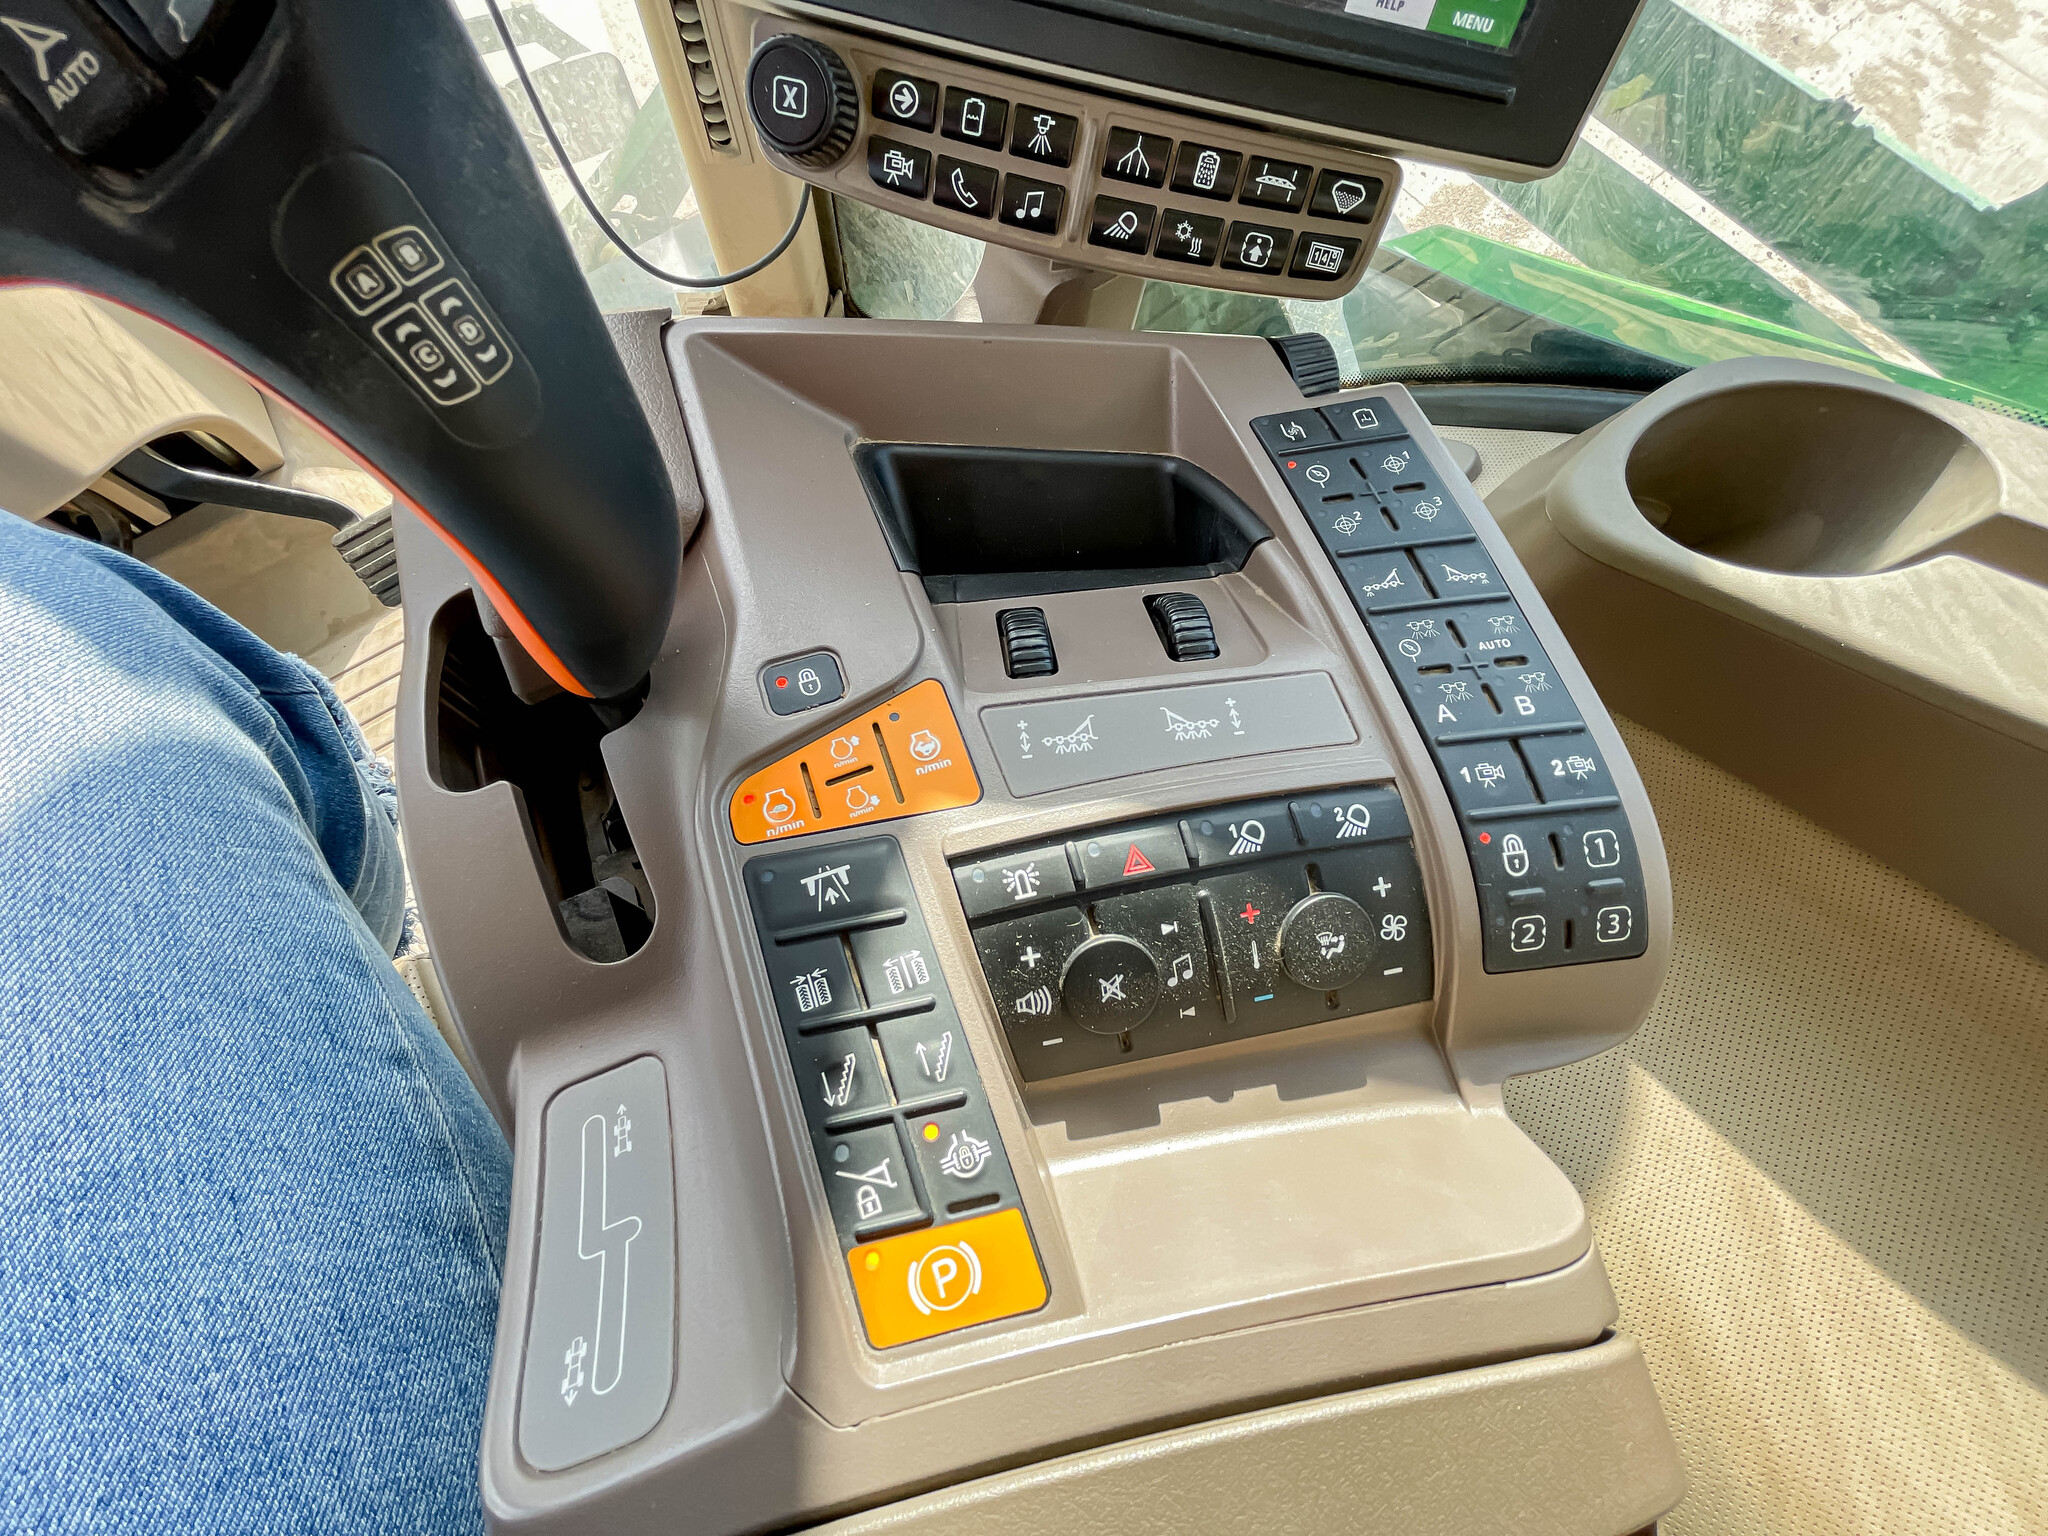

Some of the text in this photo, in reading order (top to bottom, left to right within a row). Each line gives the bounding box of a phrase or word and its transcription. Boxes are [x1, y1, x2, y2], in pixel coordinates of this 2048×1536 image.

[1452, 11, 1495, 34] MENU
[48, 51, 100, 110] AUTO
[782, 84, 798, 110] X
[356, 272, 378, 293] A
[459, 321, 478, 340] D
[1402, 450, 1411, 460] 1
[1432, 496, 1443, 506] 3
[1352, 511, 1363, 521] 2
[1479, 638, 1511, 651] AUTO
[1438, 704, 1457, 723] A
[1514, 695, 1536, 716] B
[915, 758, 952, 776] n/min
[1459, 766, 1472, 784] 1
[1551, 759, 1566, 777] 2
[1333, 807, 1345, 823] 2
[766, 819, 805, 837] n/min
[1228, 823, 1239, 839] 1
[1594, 837, 1606, 859] 1
[1520, 923, 1536, 944] 2
[1607, 913, 1620, 935] 3
[931, 1257, 957, 1299] P
